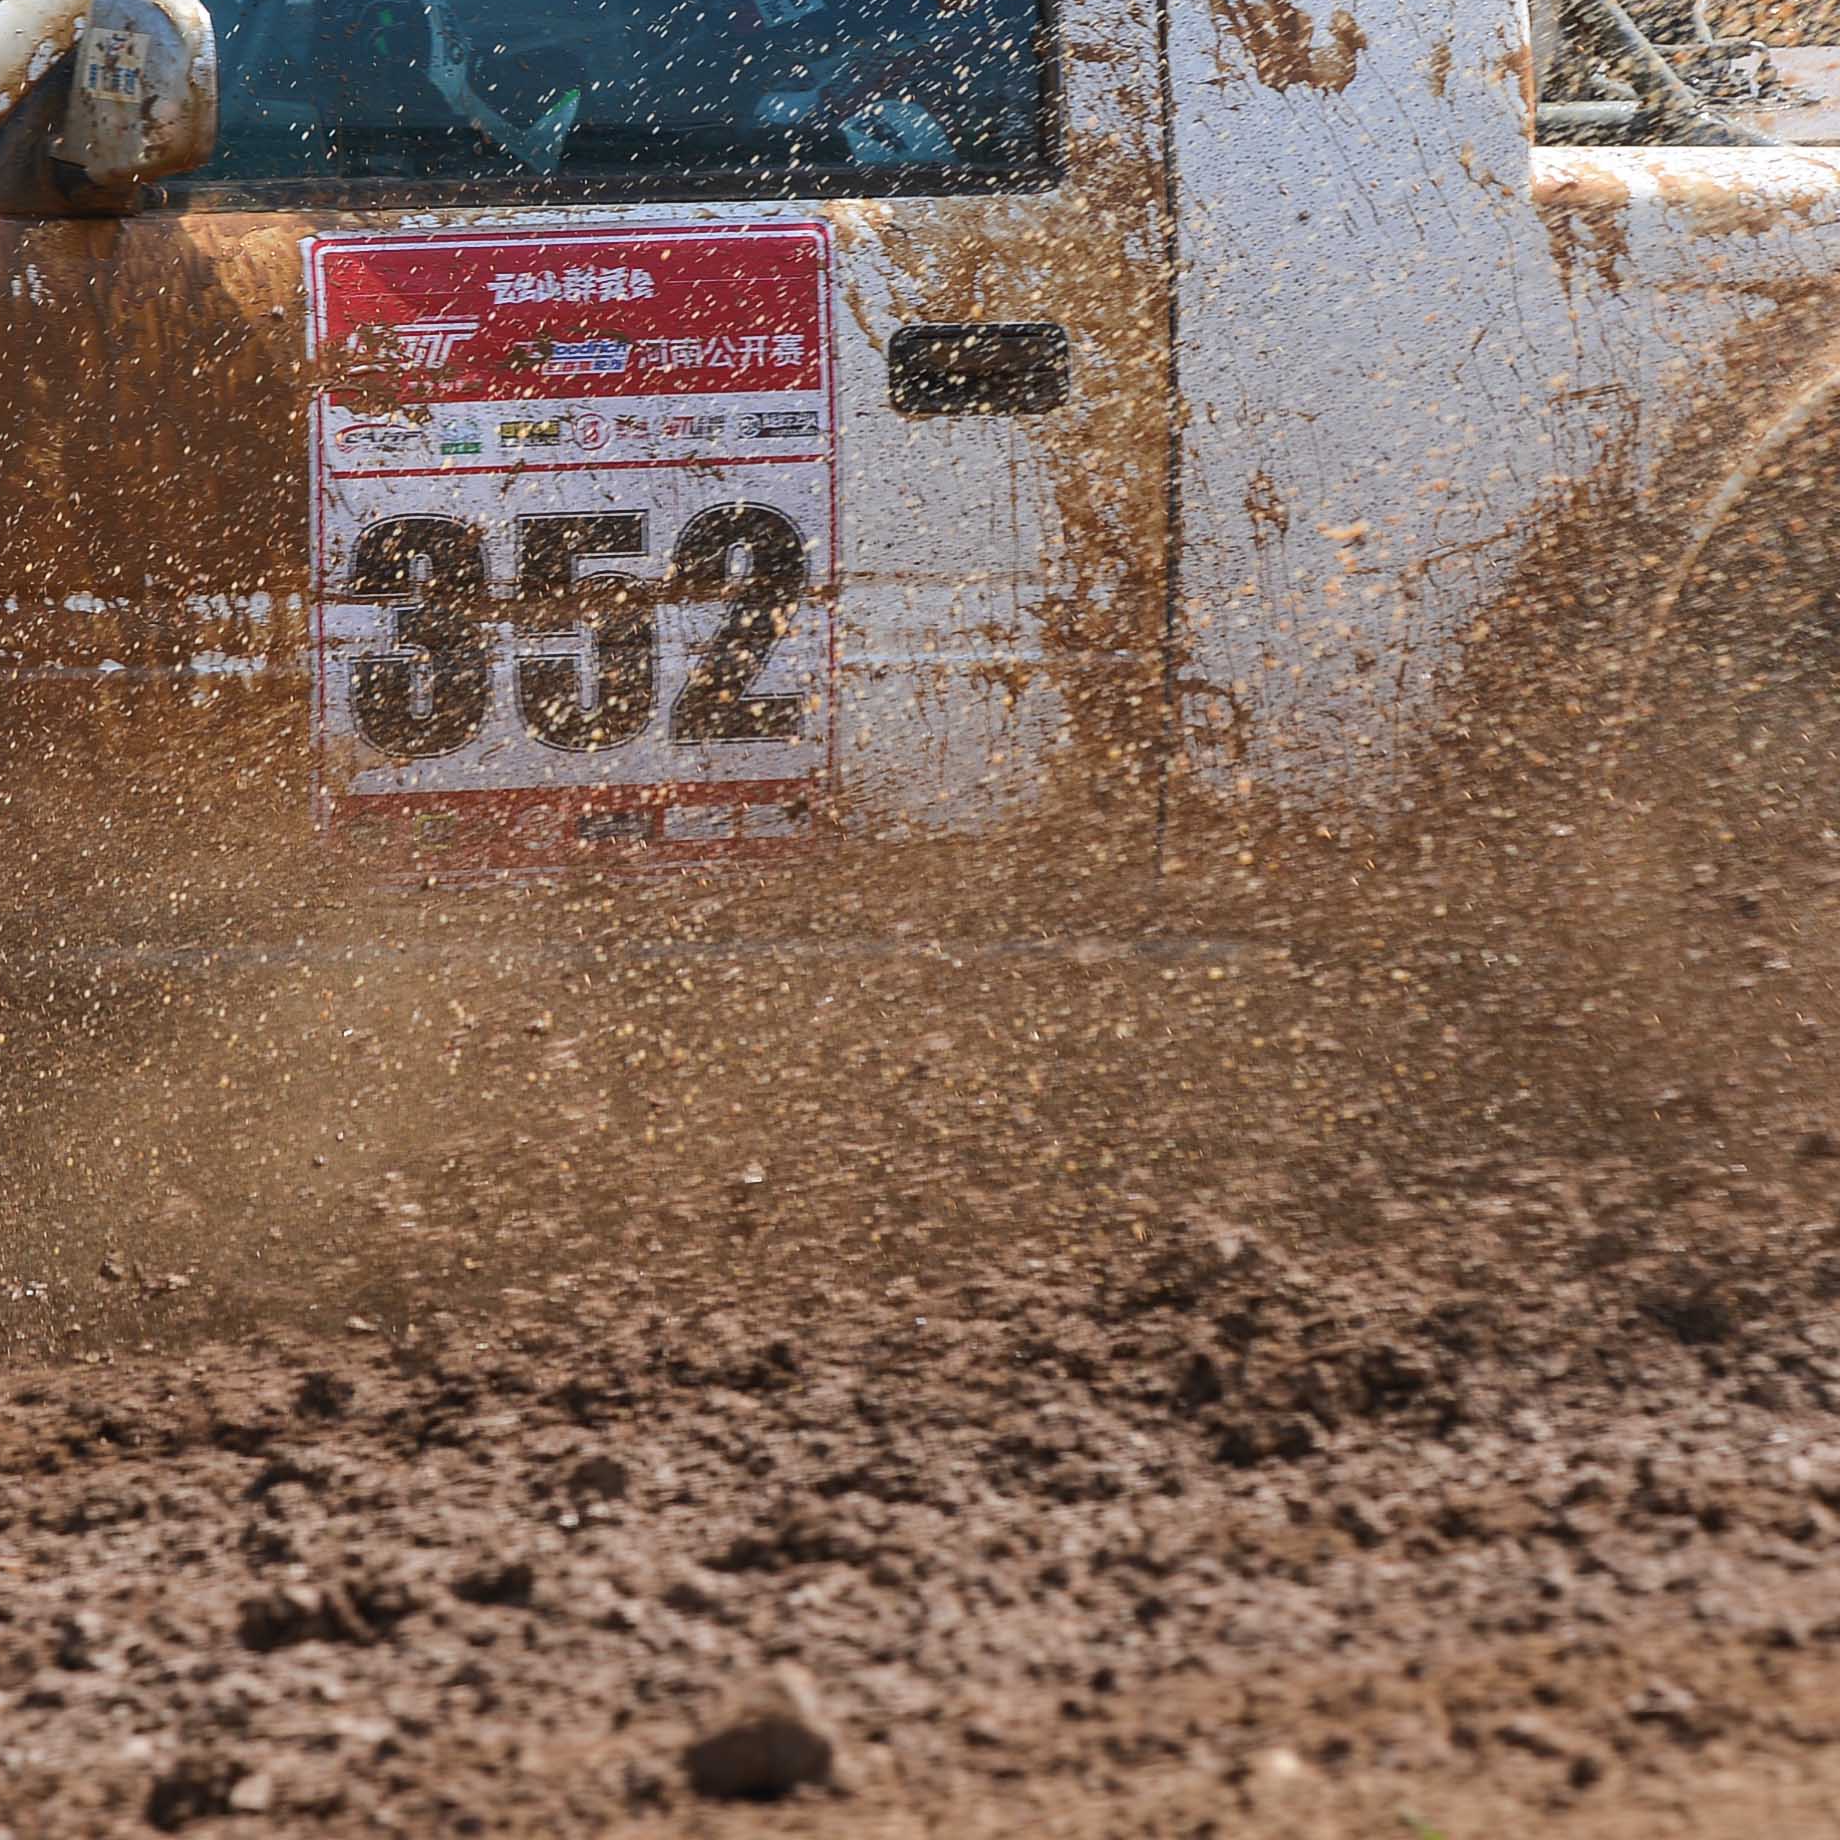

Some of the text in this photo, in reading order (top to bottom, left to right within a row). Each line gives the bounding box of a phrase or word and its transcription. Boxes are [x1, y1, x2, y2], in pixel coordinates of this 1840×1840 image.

[637, 333, 806, 370] 河南公开赛
[348, 500, 811, 759] 352
